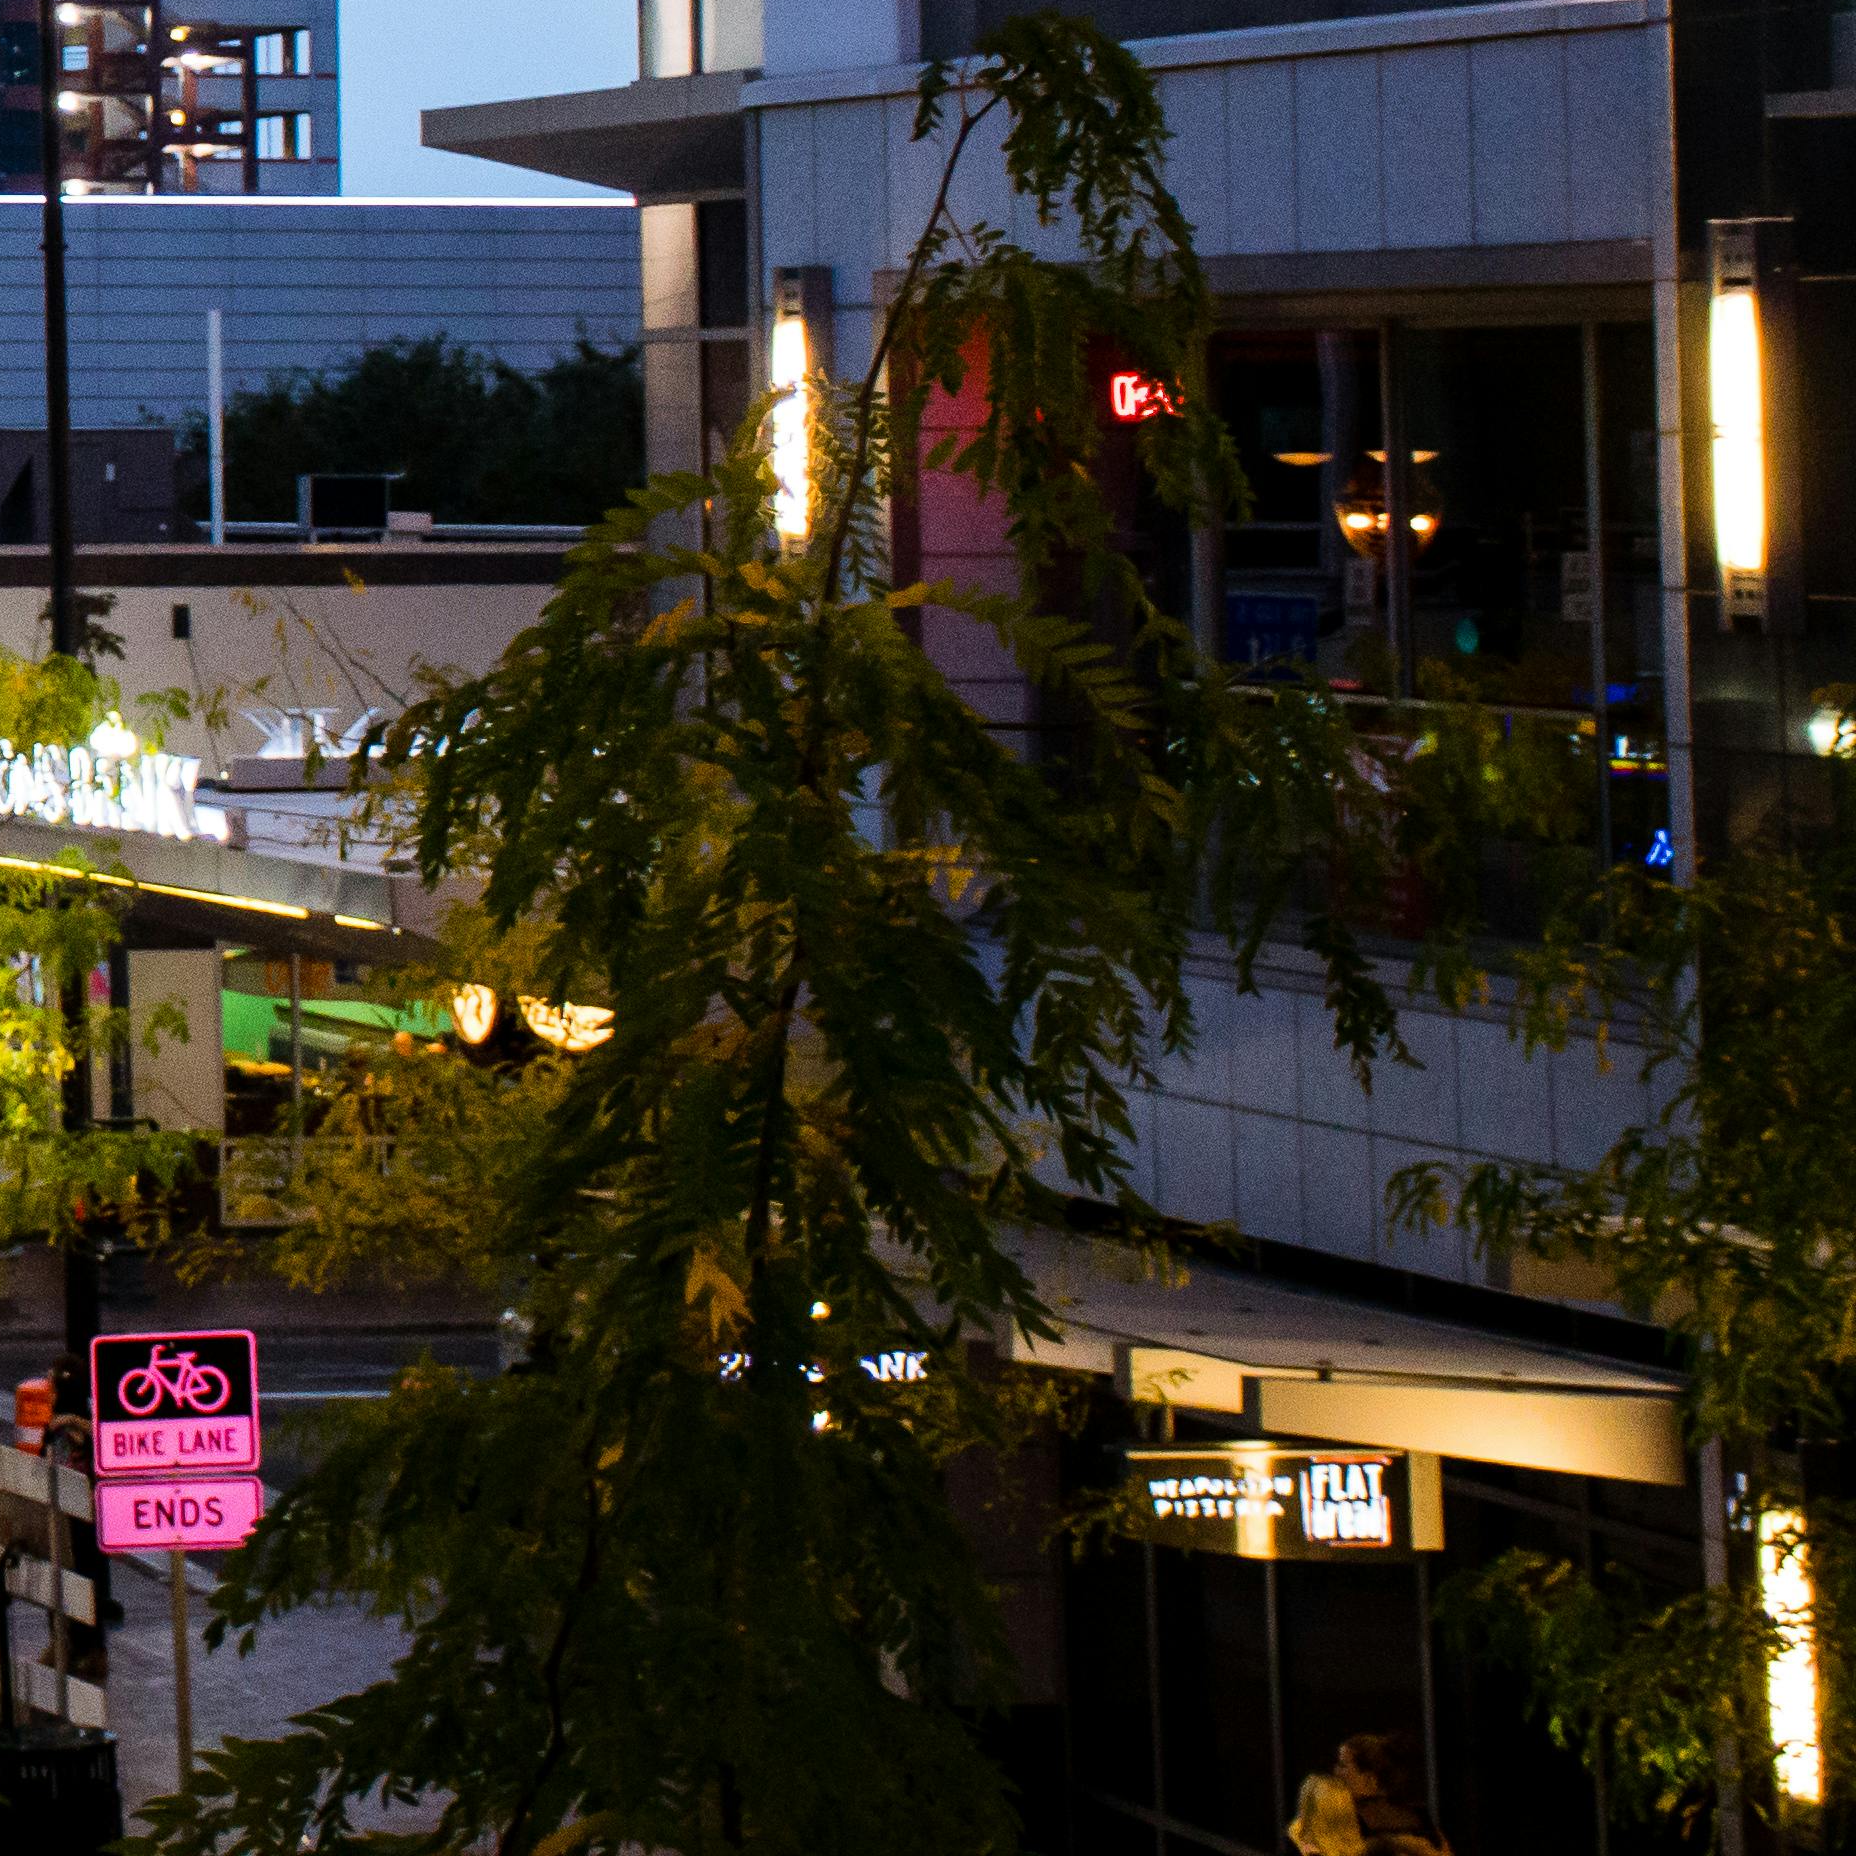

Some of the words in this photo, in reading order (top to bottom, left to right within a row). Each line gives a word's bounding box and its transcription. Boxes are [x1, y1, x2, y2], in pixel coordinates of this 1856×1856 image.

[114, 1430, 166, 1457] BIKE
[178, 1428, 238, 1454] LANE
[1310, 1464, 1384, 1500] FLAT
[133, 1496, 224, 1530] ENDS
